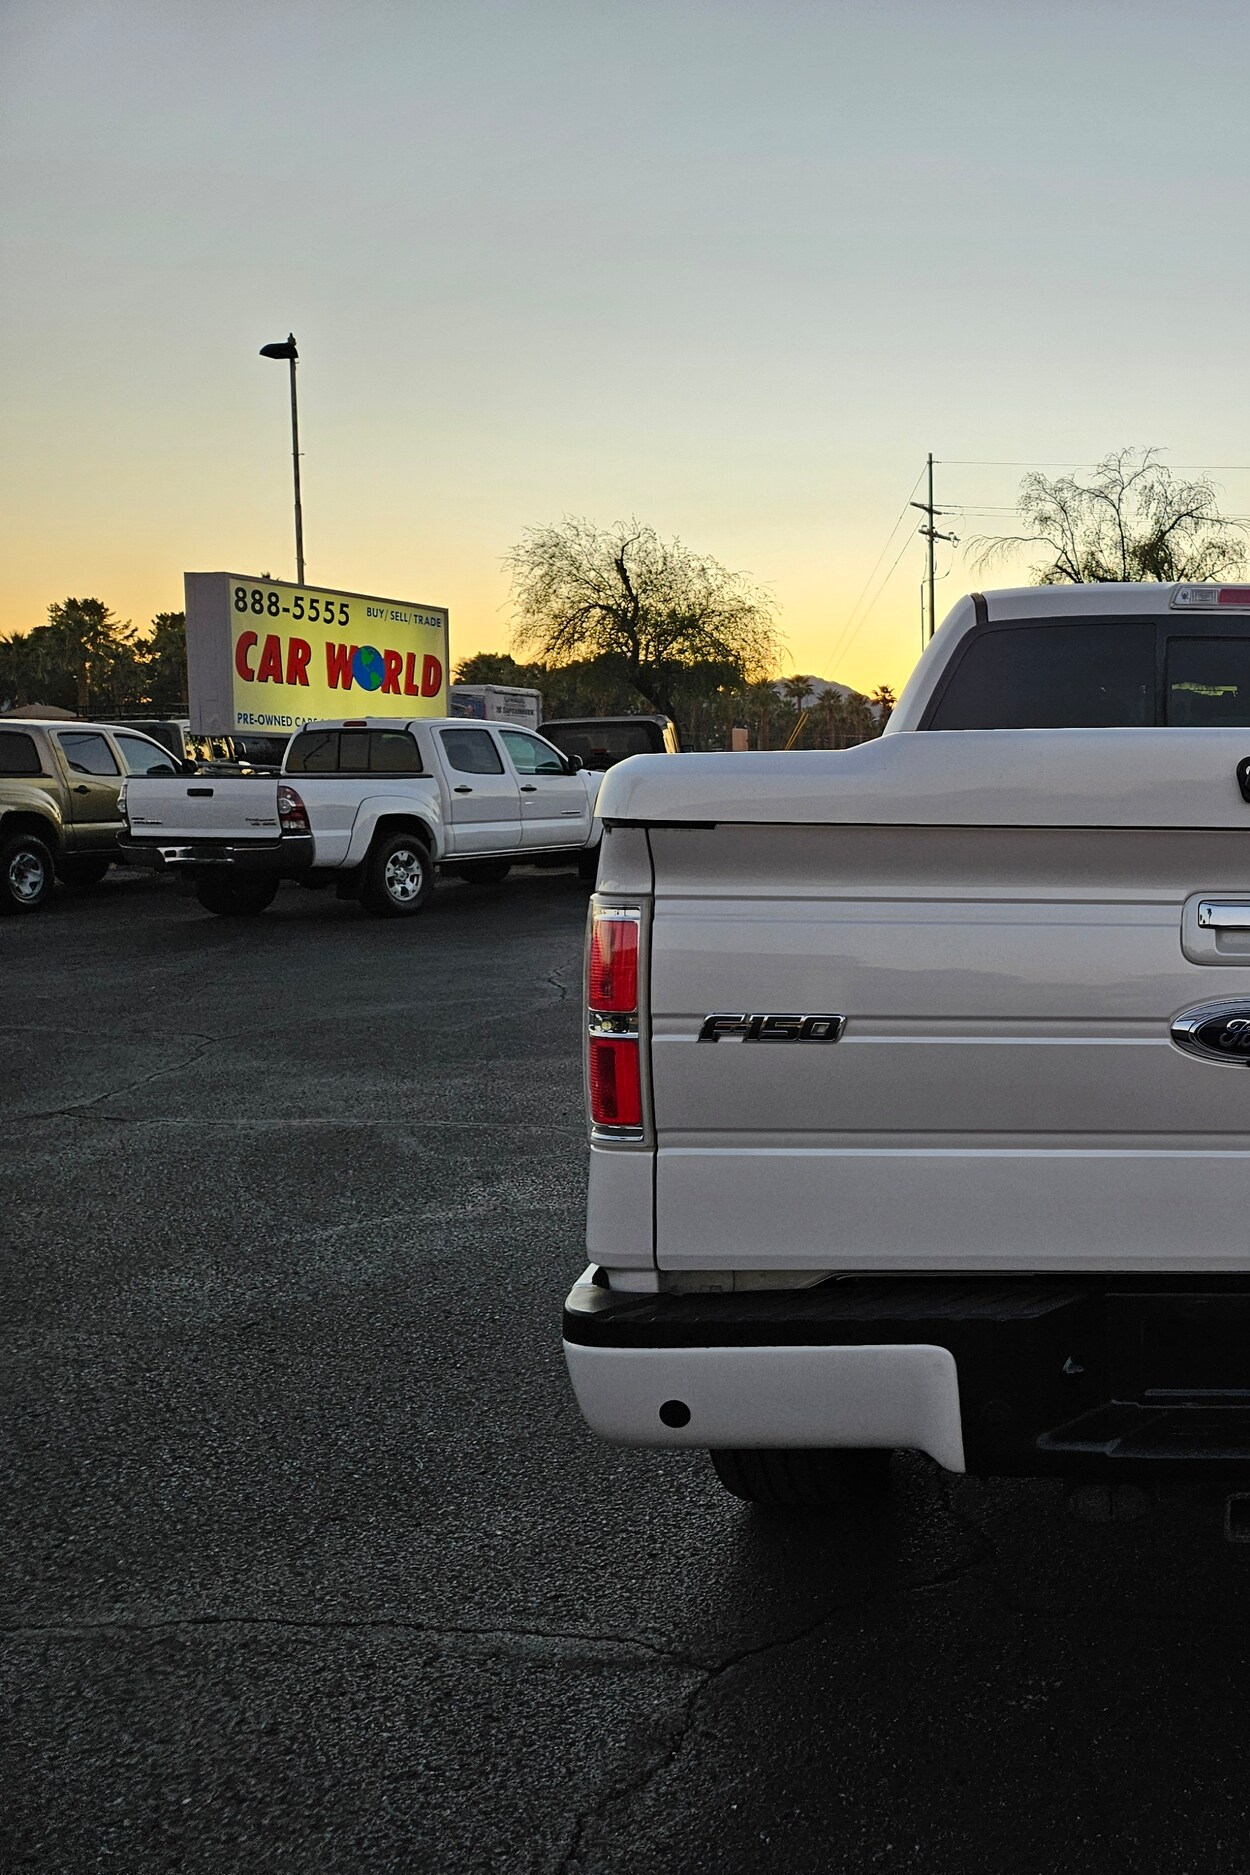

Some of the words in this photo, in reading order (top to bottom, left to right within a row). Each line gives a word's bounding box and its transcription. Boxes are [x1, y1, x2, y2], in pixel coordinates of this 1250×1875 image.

[234, 586, 350, 626] 888-5555
[413, 614, 442, 628] TRADE
[235, 630, 312, 687] CAR
[325, 641, 443, 698] WORLD
[237, 712, 293, 727] PRE-OWNED
